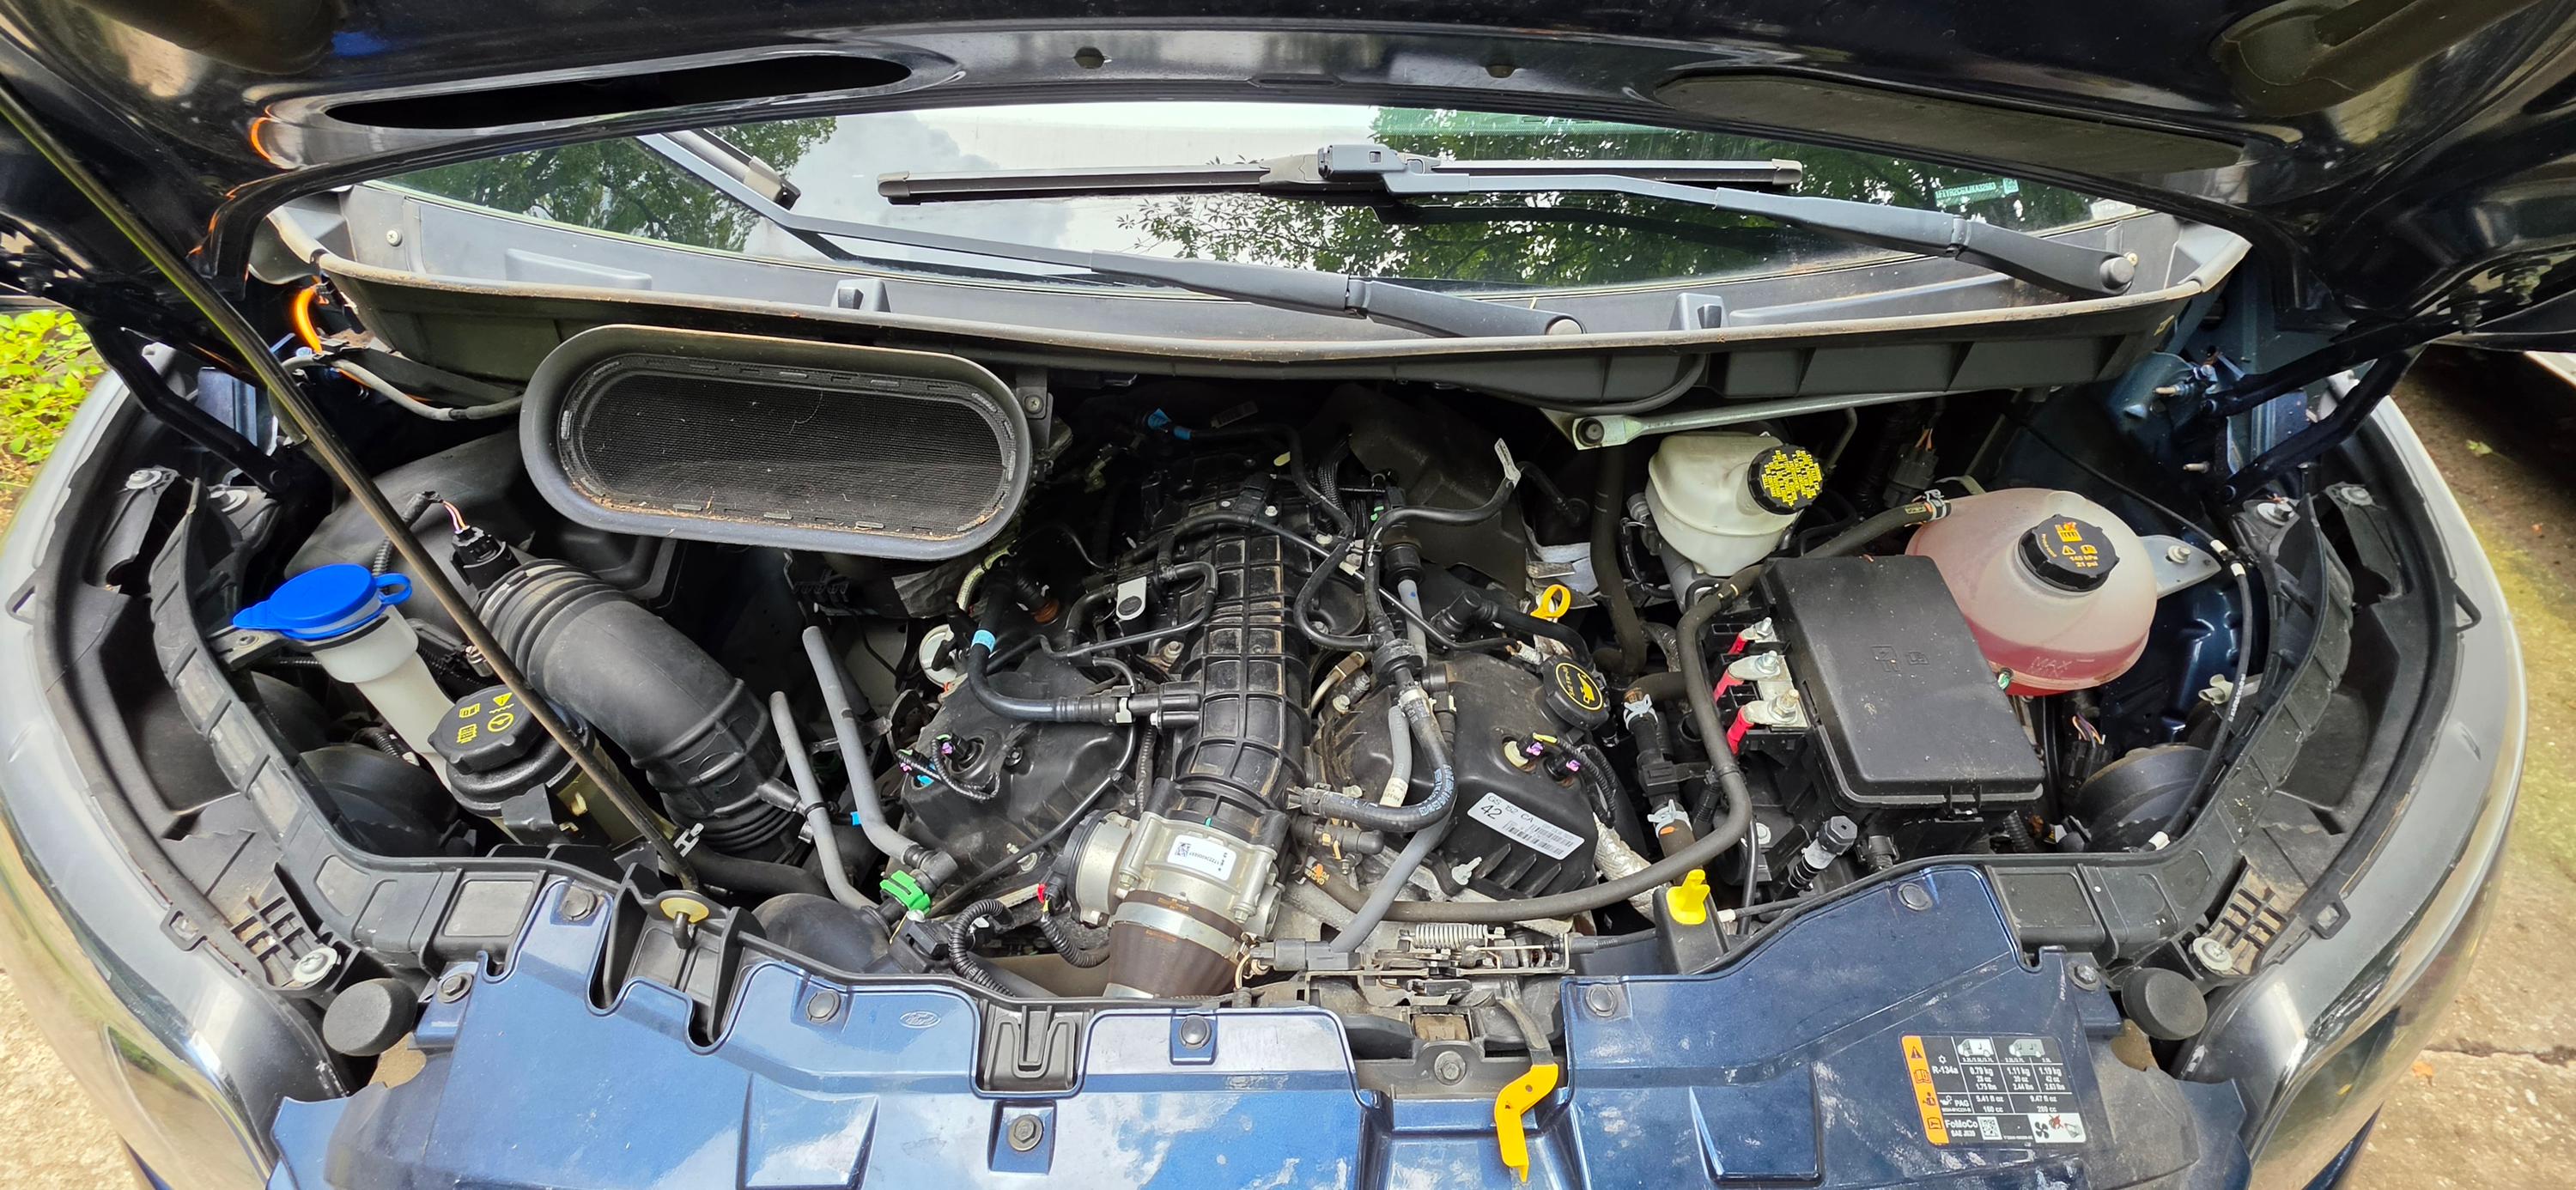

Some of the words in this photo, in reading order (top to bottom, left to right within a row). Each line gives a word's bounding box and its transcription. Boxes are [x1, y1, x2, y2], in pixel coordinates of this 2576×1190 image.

[2030, 656, 2073, 671] MAX
[1480, 804, 1503, 820] 42
[1931, 1066, 1959, 1074] R-134a
[1984, 1066, 1994, 1077] kg
[2020, 1066, 2031, 1077] kg
[2052, 1066, 2062, 1077] kg
[1944, 1120, 1978, 1128] FoMoCo
